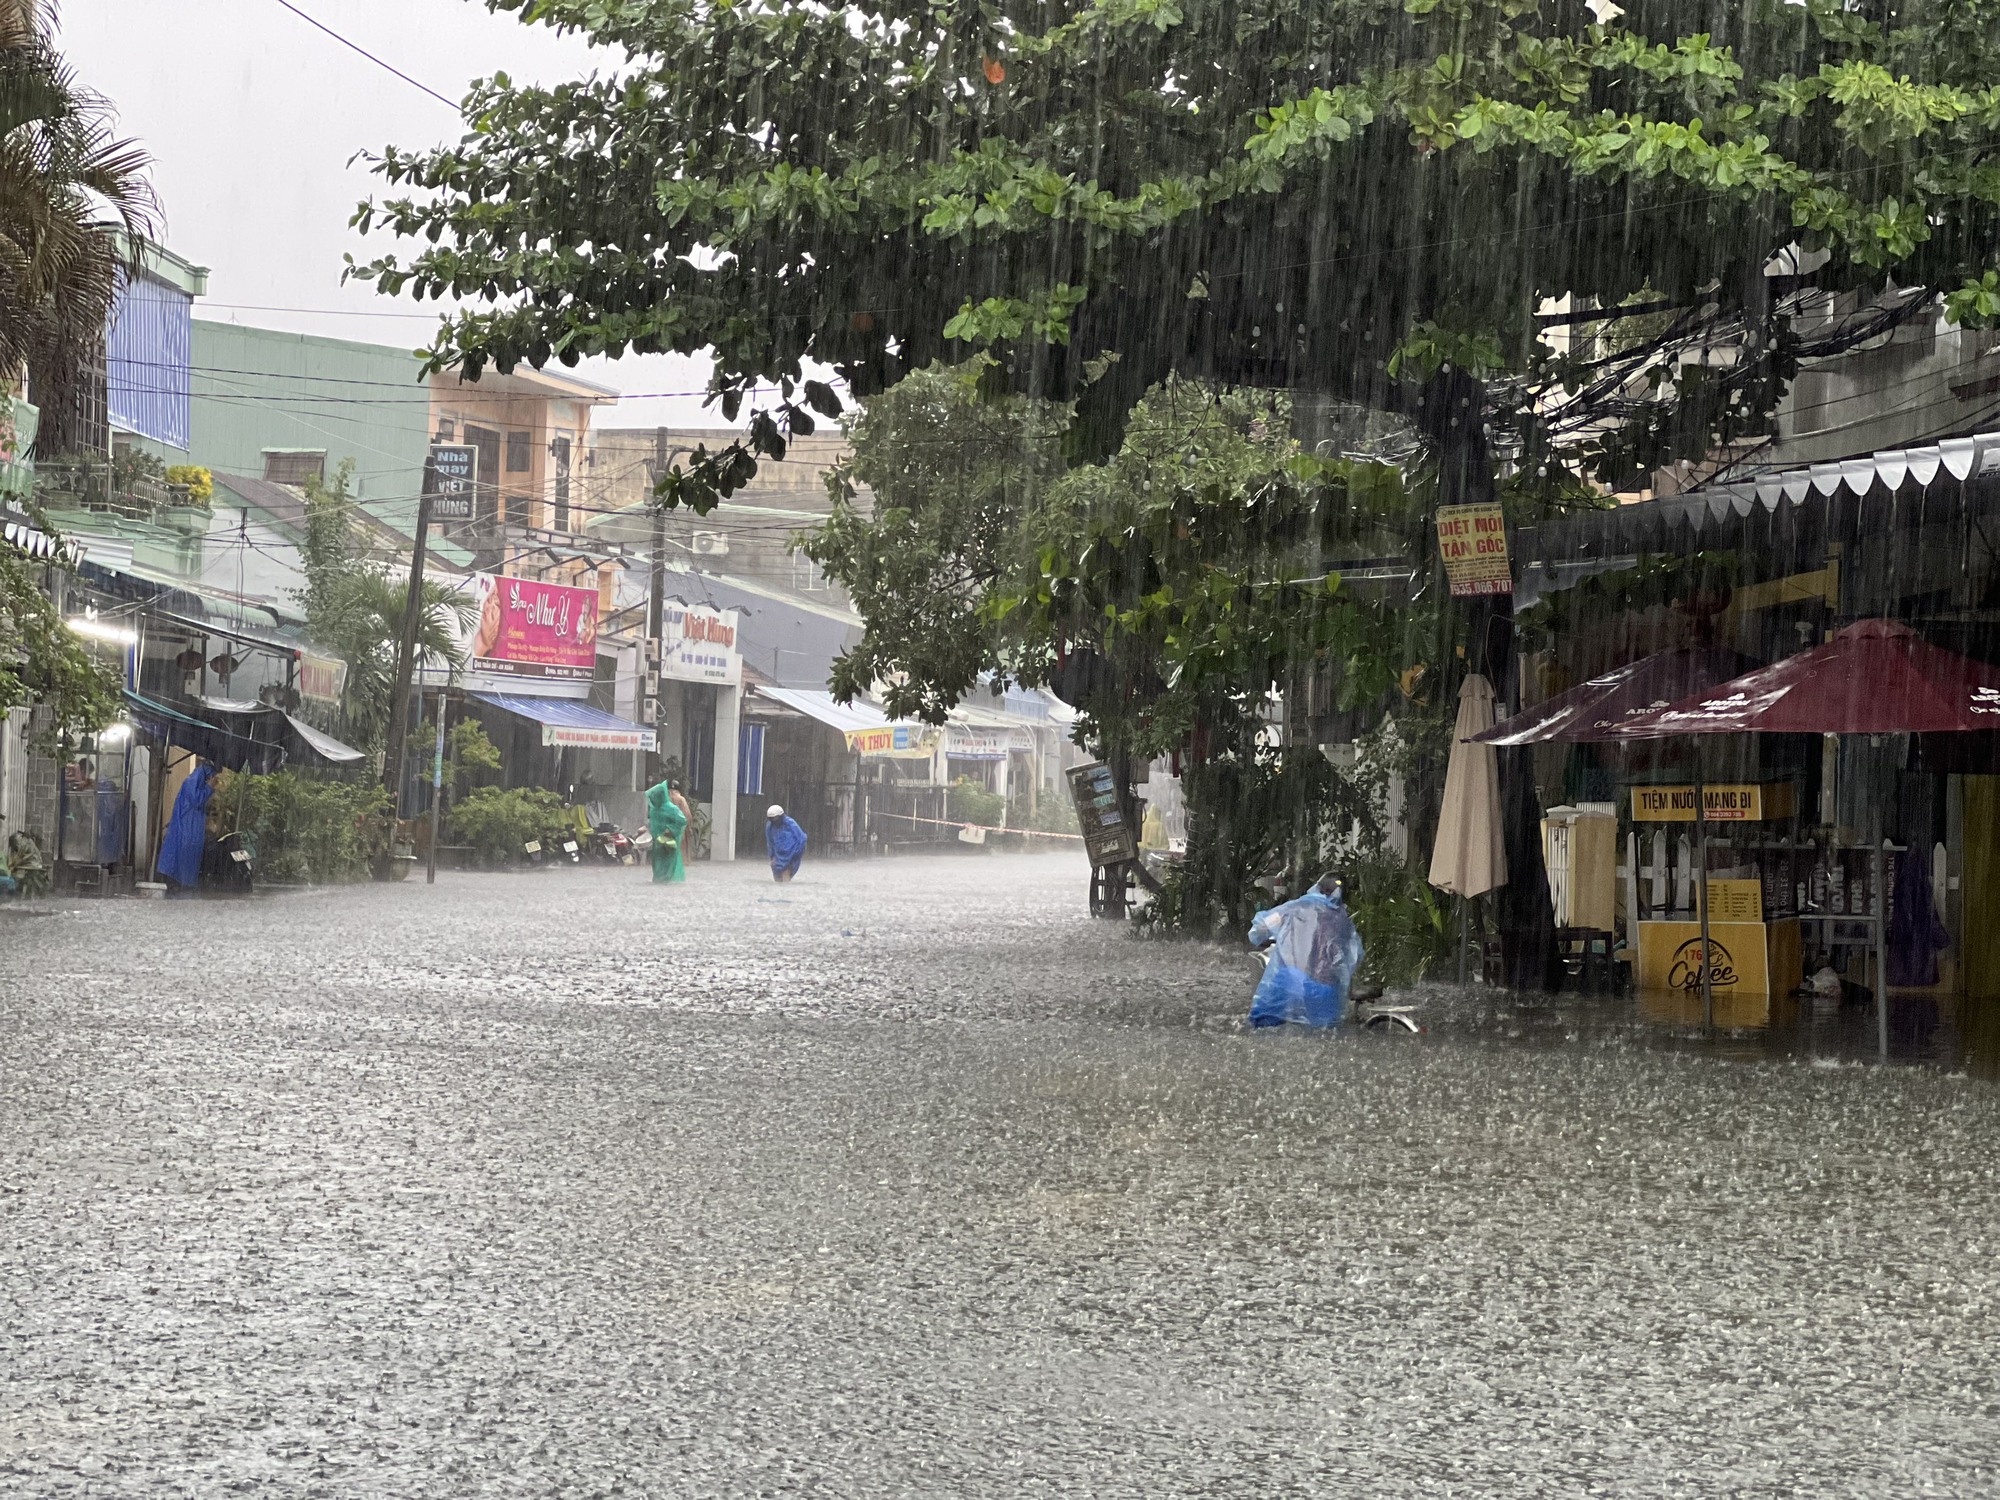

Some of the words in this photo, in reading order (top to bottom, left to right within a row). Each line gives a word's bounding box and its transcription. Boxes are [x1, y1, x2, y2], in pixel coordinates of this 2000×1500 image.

[437, 451, 468, 462] Nhà
[1439, 517, 1470, 538] DIỆT
[1475, 512, 1503, 532] MỐI
[1476, 533, 1504, 554] GỐC
[706, 615, 734, 648] Hùng
[1641, 785, 1669, 808] TIỆM
[1671, 784, 1697, 804] NƯỚ
[1704, 787, 1737, 804] MANG
[1740, 787, 1751, 803] ĐI
[1684, 949, 1703, 961] 176
[1668, 960, 1739, 994] Cofee
